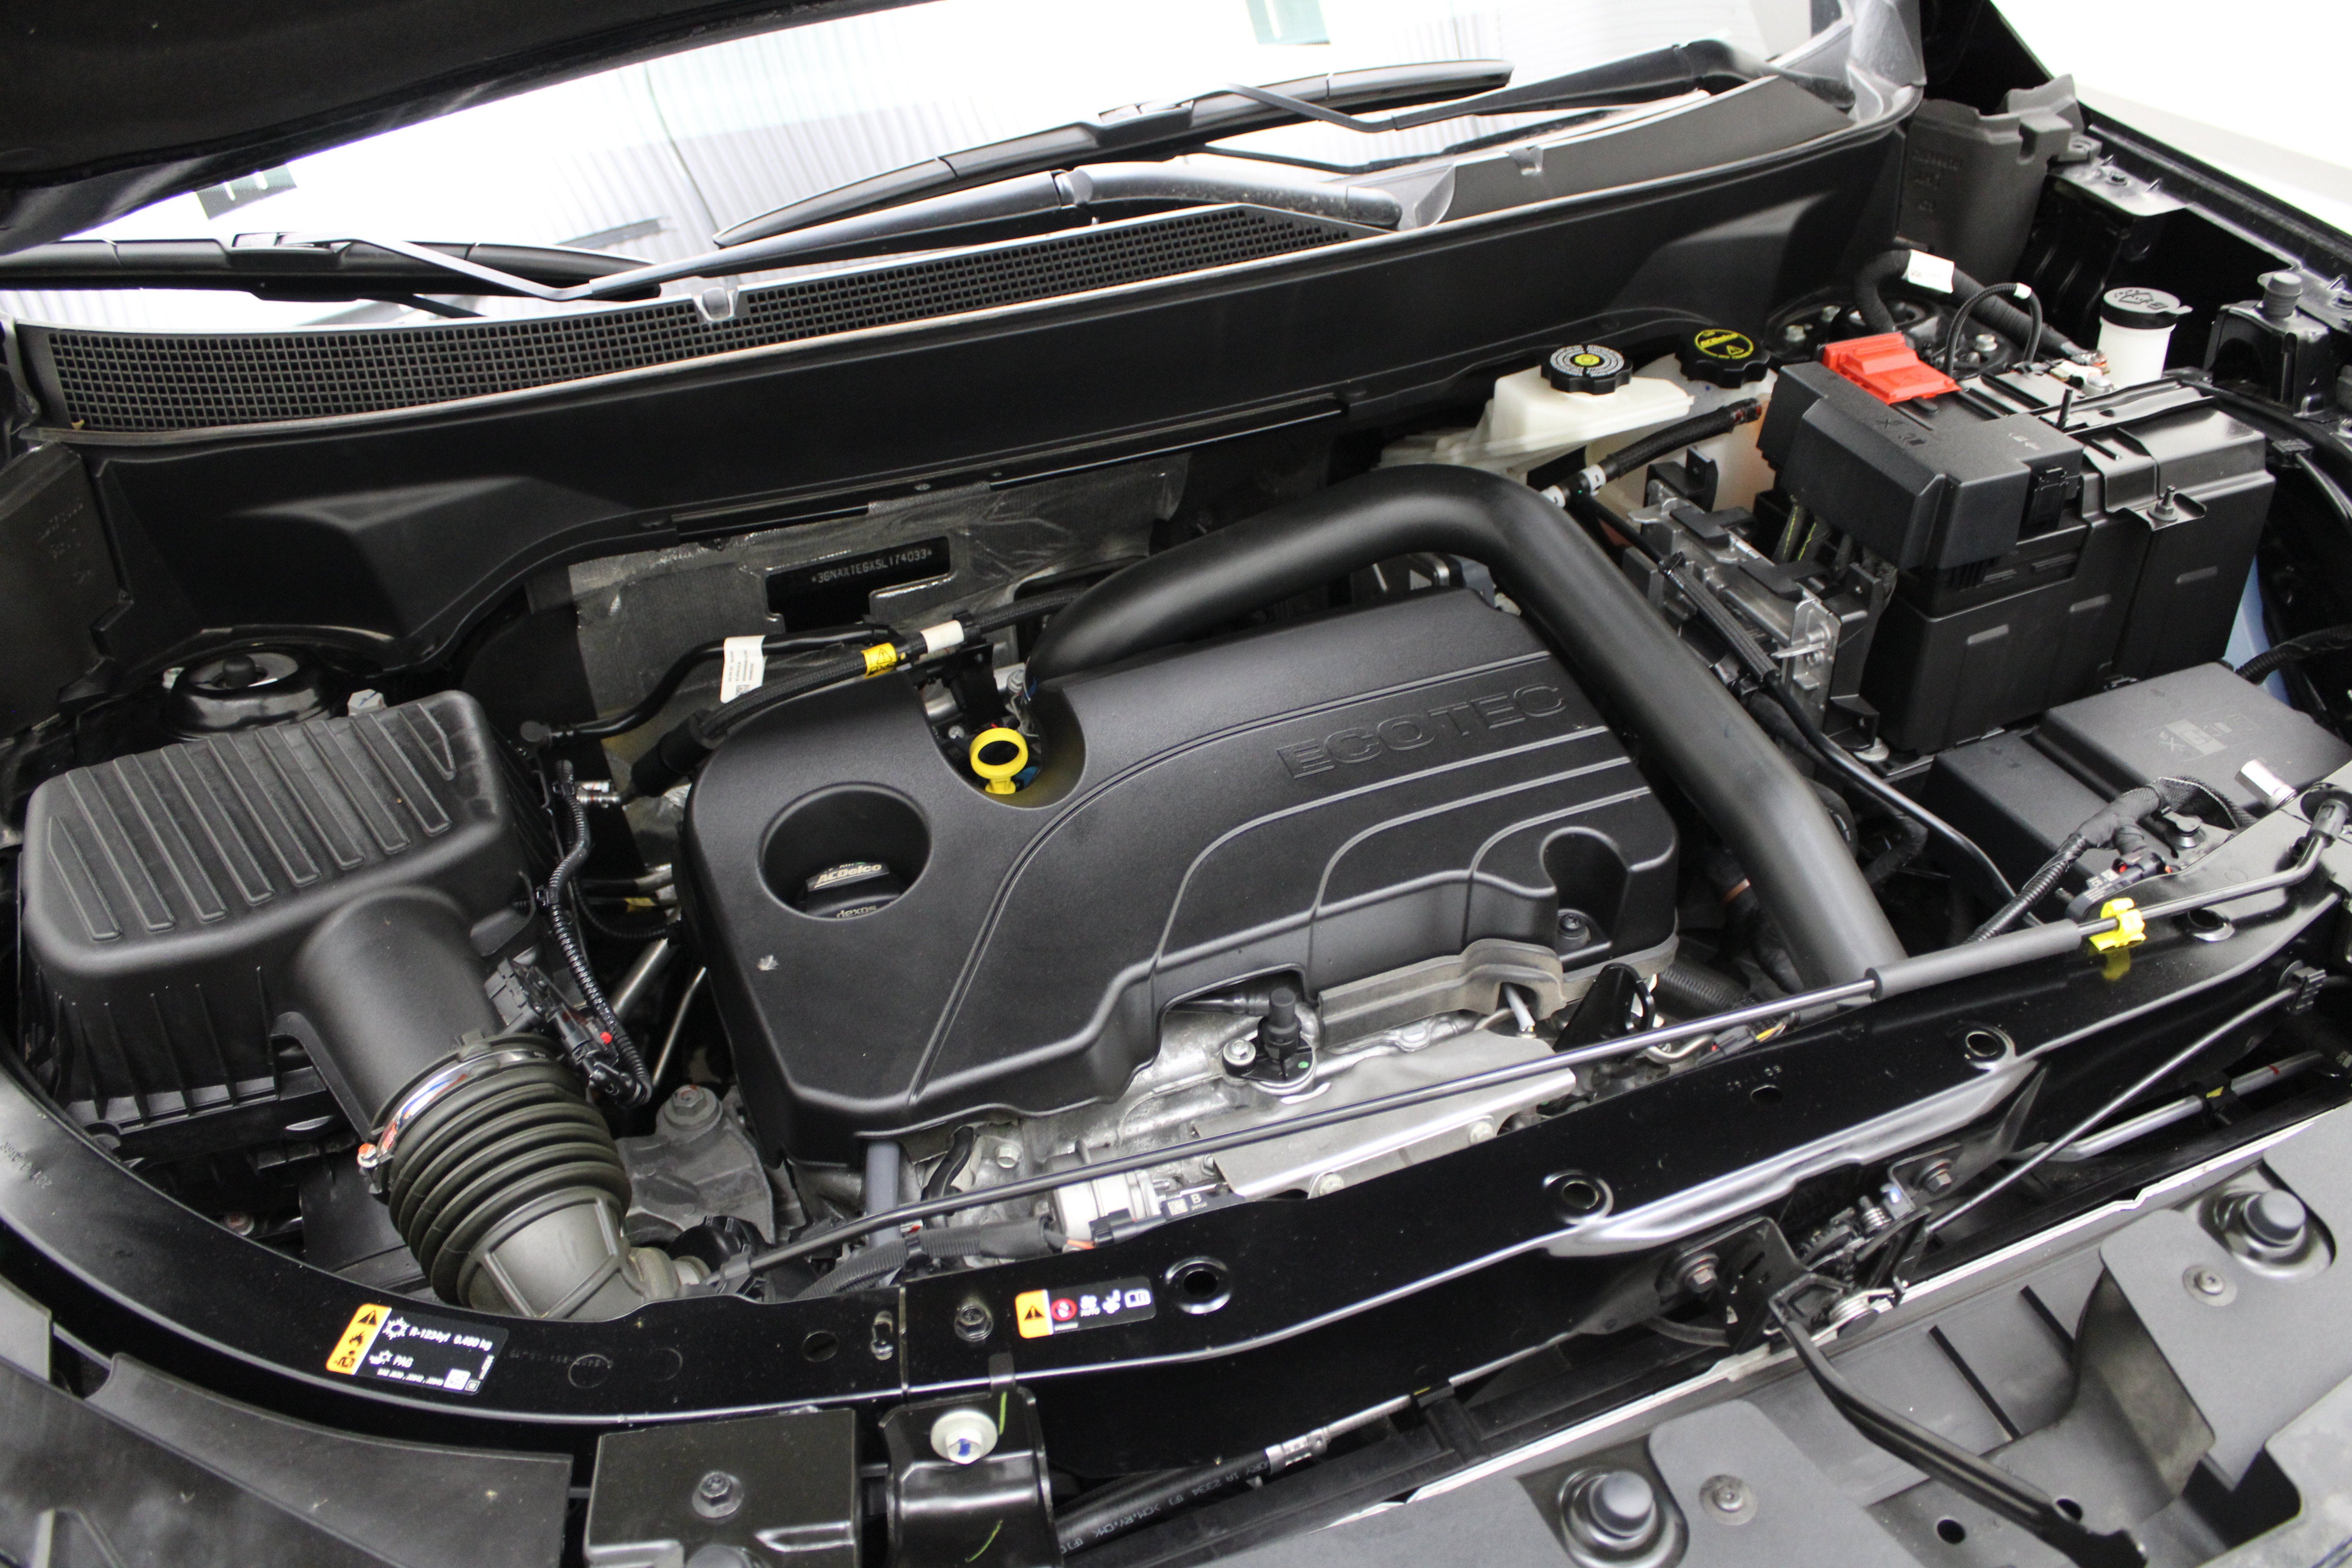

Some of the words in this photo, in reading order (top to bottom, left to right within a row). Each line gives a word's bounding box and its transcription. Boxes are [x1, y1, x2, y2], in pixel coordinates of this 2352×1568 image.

[1277, 683, 1566, 779] ECOTEC
[816, 864, 882, 884] ACDelco
[836, 904, 878, 918] dexos
[1190, 1193, 1202, 1204] B
[409, 1326, 451, 1343] R-1234yf
[479, 1339, 492, 1351] kg
[393, 1354, 414, 1368] PAG
